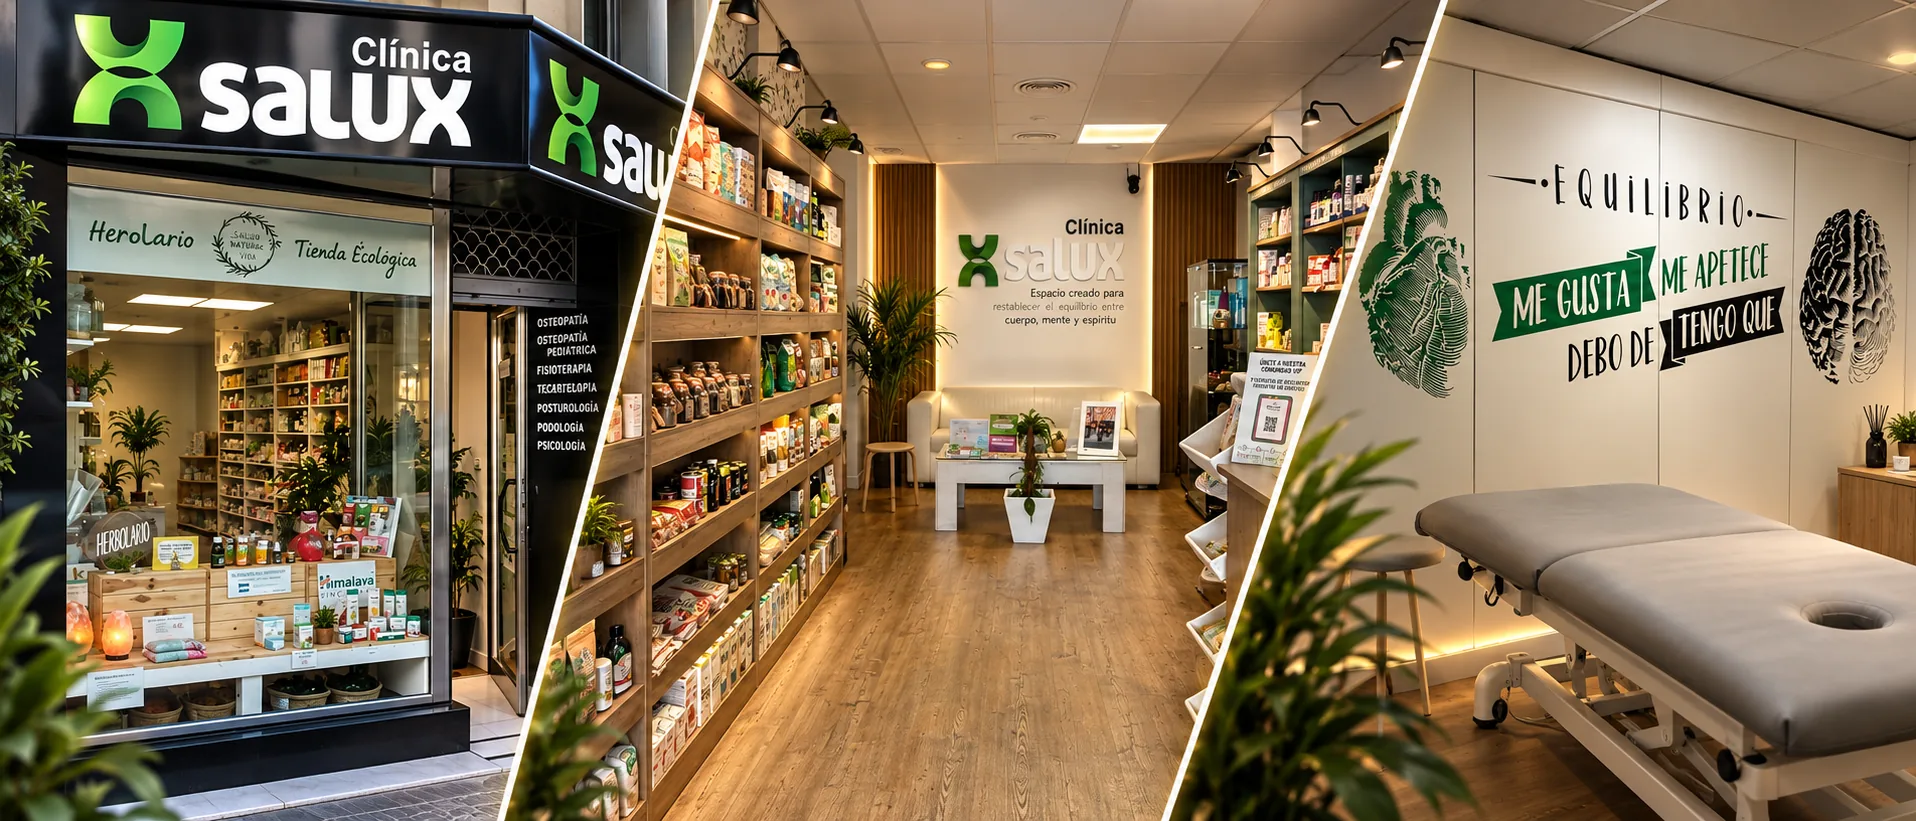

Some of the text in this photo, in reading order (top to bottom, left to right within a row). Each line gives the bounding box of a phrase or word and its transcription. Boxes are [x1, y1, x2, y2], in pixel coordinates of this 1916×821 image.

[352, 36, 472, 73] Clínica
[89, 220, 194, 248] Herolario
[1065, 218, 1124, 235] Clínica
[295, 240, 346, 260] Tienda
[1662, 243, 1769, 296] ME APETECE
[993, 302, 1041, 311] restablecer
[1045, 302, 1054, 311] el
[1101, 303, 1125, 311] entre
[1030, 288, 1124, 299] Espacio creado para
[1513, 269, 1631, 329] ME GUSTA
[1004, 316, 1039, 326] cuerpo,
[1041, 316, 1071, 325] mente
[1073, 318, 1080, 327] y
[1678, 296, 1775, 349] TENGO QUE
[1568, 327, 1655, 382] DEBO DE
[537, 363, 592, 375] FISIOTERAPIA
[96, 521, 150, 557] HERBOLARIO
